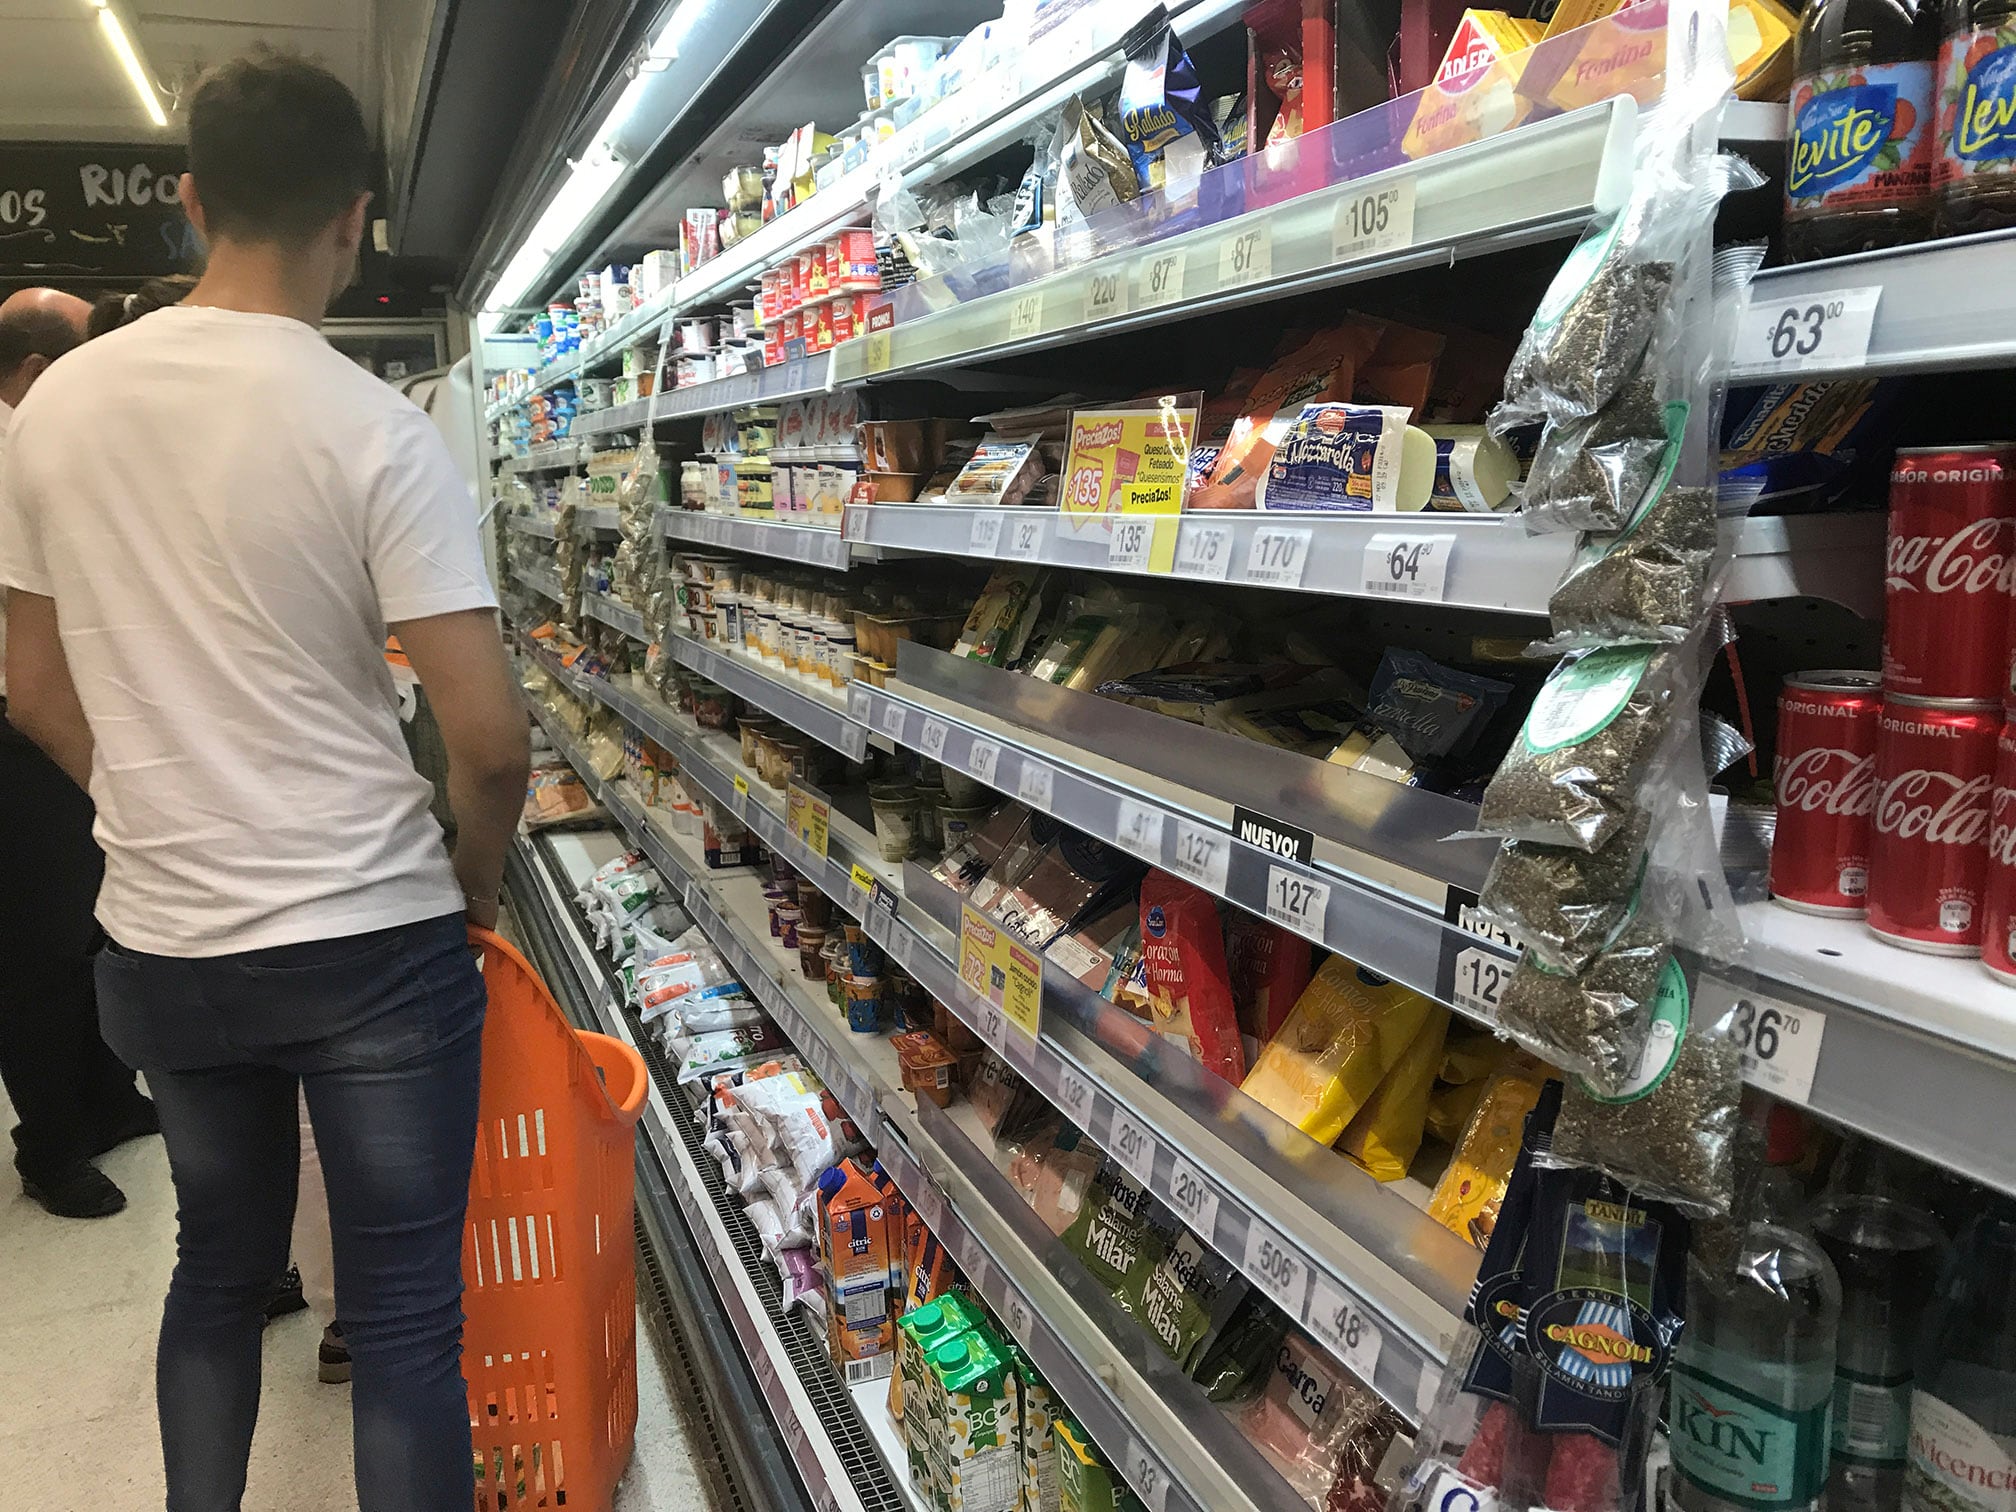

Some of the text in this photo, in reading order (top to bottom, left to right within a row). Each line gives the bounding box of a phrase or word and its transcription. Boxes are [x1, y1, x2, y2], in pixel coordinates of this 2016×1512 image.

[1443, 48, 1497, 80] ADLER
[1577, 40, 1654, 86] Fontina
[1123, 105, 1177, 142] Rallado
[1416, 101, 1458, 138] Fontina
[1789, 107, 1882, 191] Levite
[1070, 162, 1104, 206] Rallado
[871, 311, 892, 330] PROMO!
[1144, 444, 1163, 457] Queso
[1131, 487, 1171, 504] PreciaZos!
[1785, 701, 1858, 718] ORIGINAL
[1883, 717, 1961, 739] ORIGINAL
[1240, 819, 1299, 861] NUEVO!
[1141, 938, 1180, 964] Corazón
[1152, 962, 1184, 982] Horma
[1098, 1204, 1138, 1242] Salame
[847, 1236, 872, 1249] citric
[1152, 1262, 1184, 1313] Salame
[1141, 1275, 1182, 1354] Milán
[1547, 1323, 1653, 1364] CAGNOLI
[969, 1407, 999, 1432] BC
[1677, 1392, 1777, 1466] KIN
[1060, 1441, 1081, 1495] BC
